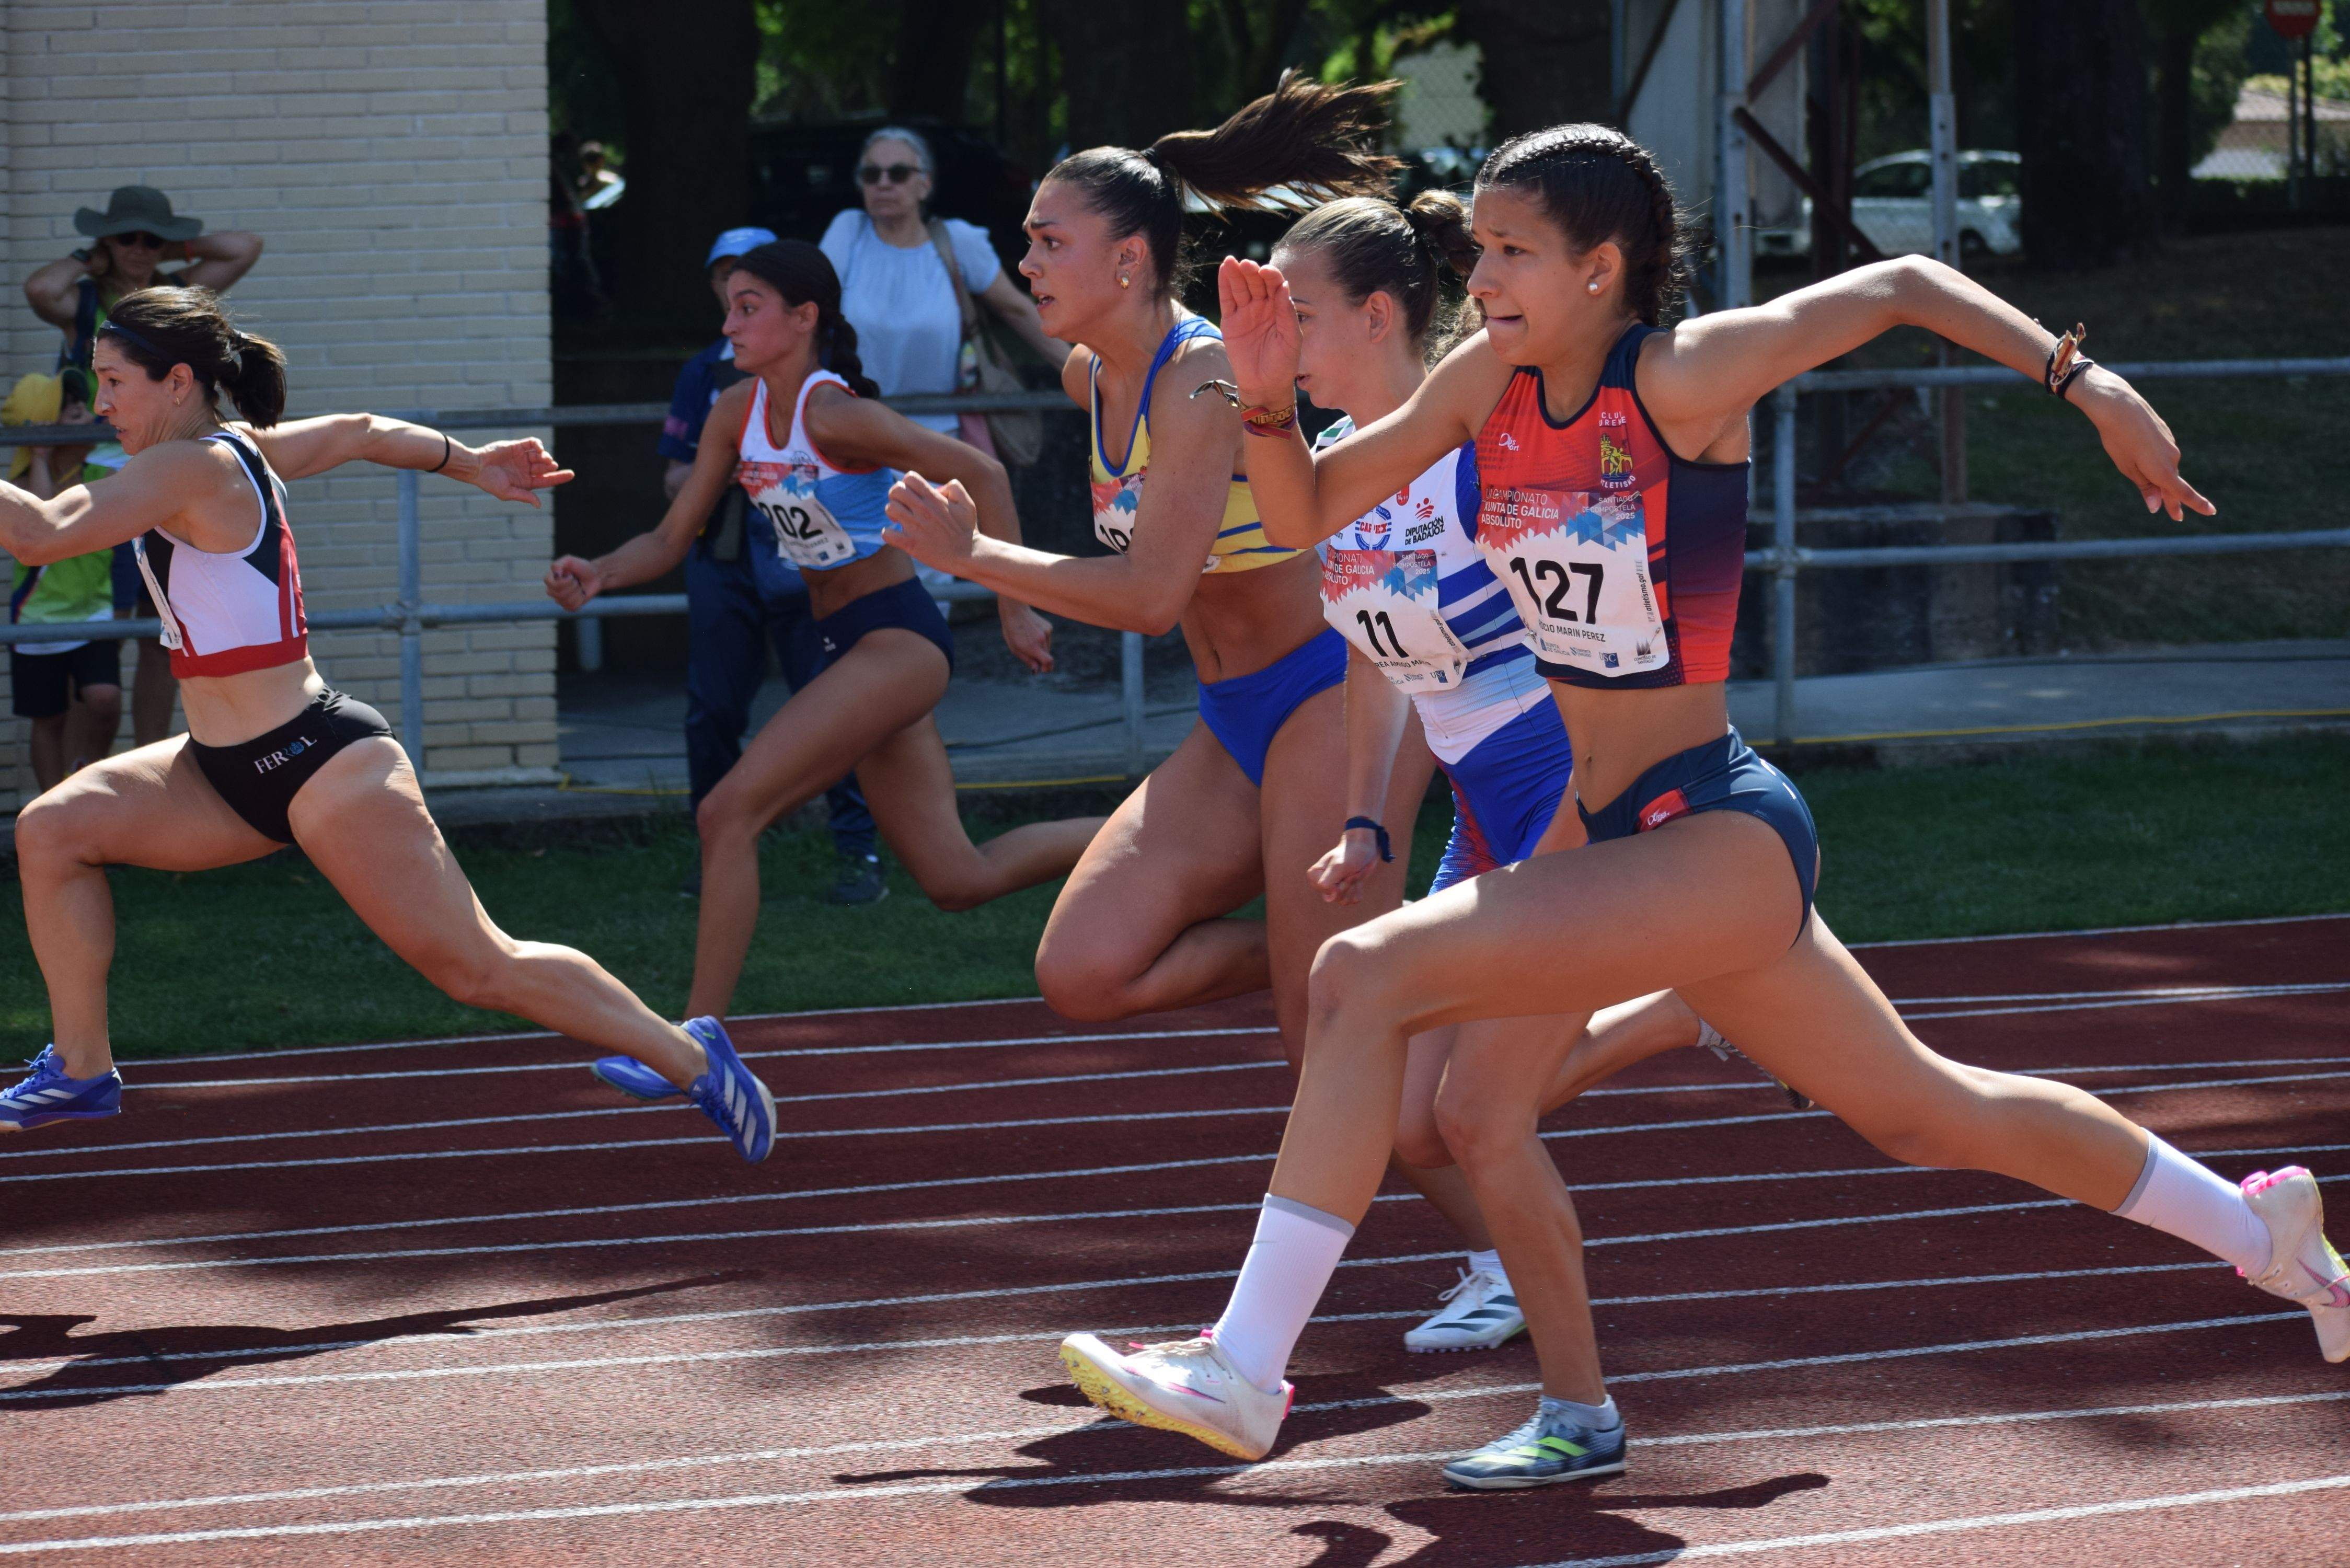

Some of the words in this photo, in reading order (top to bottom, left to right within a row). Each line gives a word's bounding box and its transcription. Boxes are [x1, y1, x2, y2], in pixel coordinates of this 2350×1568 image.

[1493, 489, 1547, 505] CAMPIONATO
[1598, 495, 1633, 504] SANTIAGO
[1484, 501, 1505, 513] XUNTA
[1507, 503, 1518, 515] DE
[1520, 505, 1559, 520] GALICIA
[1590, 504, 1635, 513] COMPOSTELA
[1406, 515, 1444, 537] DIPUTACIÓN
[1481, 514, 1522, 529] ABSOLUTO
[1413, 524, 1445, 544] BADAJOZ
[1334, 563, 1343, 574] DE
[1510, 557, 1604, 625] 127
[1636, 573, 1652, 612] atletismo.gal
[1356, 609, 1410, 658] 11
[1433, 618, 1456, 647] atletismo.gal
[1557, 626, 1581, 638] MARIN
[1582, 630, 1606, 642] PEREZ
[1599, 652, 1617, 662] USC
[1430, 670, 1445, 679] USC
